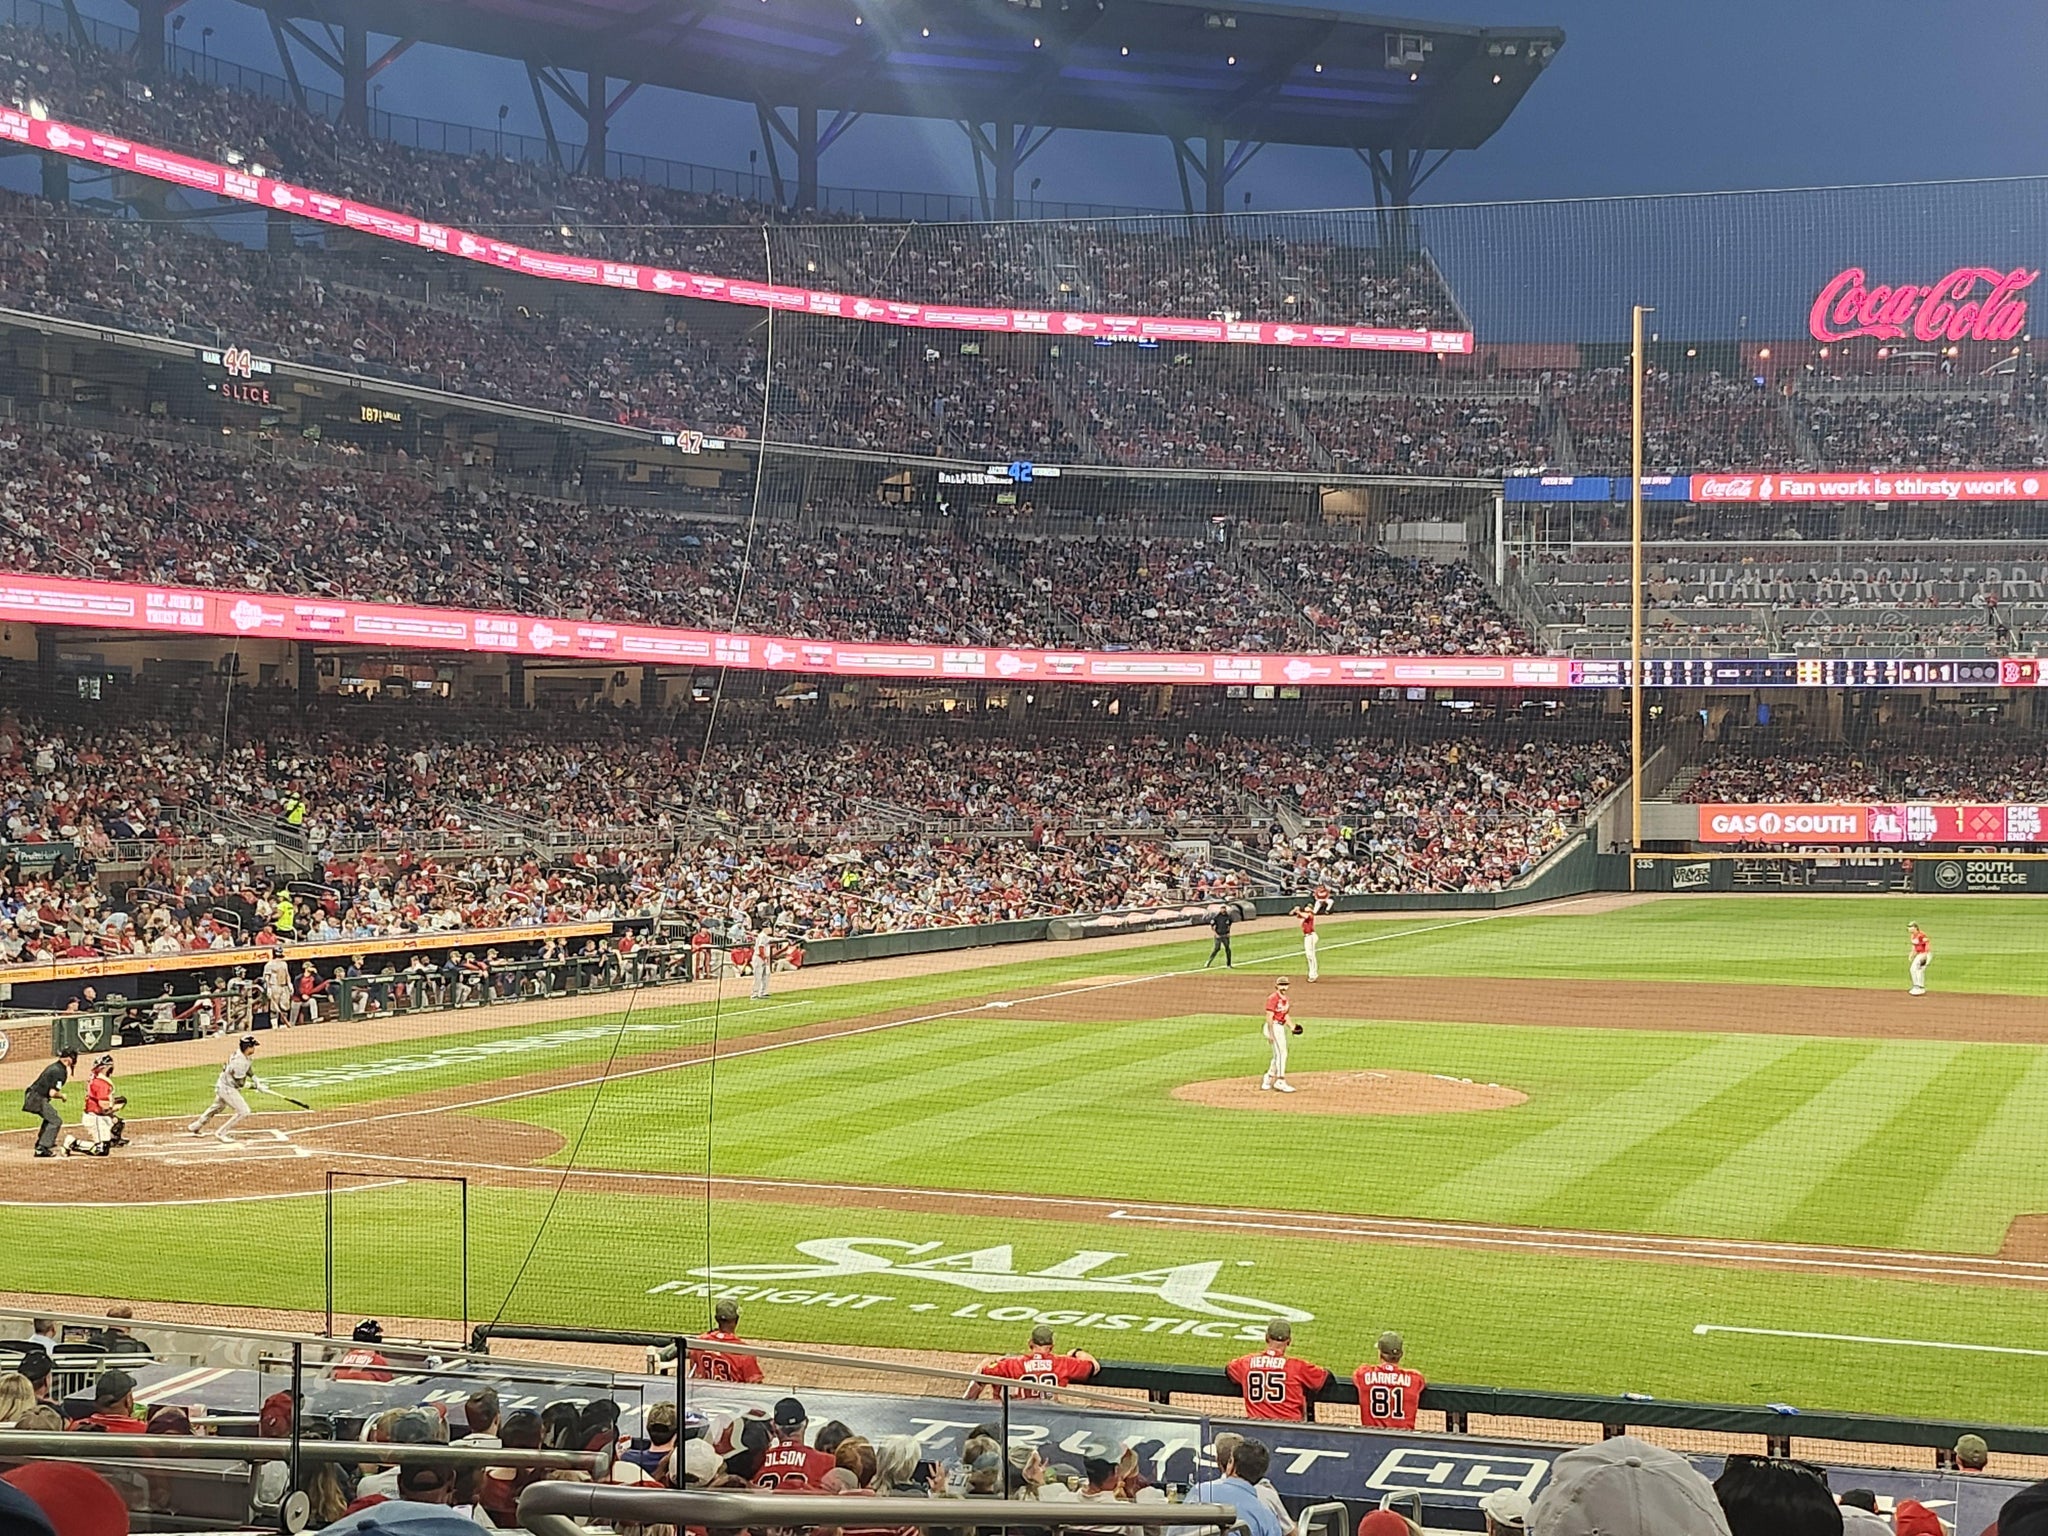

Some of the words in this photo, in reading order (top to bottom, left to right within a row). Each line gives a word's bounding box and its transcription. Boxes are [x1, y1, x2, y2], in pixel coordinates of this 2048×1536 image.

[223, 347, 252, 378] 44
[222, 383, 270, 403] SLICE
[677, 429, 703, 454] 47
[938, 472, 984, 485] BALLPARK
[1008, 461, 1034, 482] 42
[1780, 479, 1815, 496] Fan
[1819, 479, 1870, 495] work
[1874, 478, 1892, 495] is
[1895, 478, 1961, 499] thirsty
[1965, 478, 2016, 494] work
[1699, 568, 1795, 598] HANK
[1808, 568, 1941, 599] AARON
[1913, 664, 1923, 681] 1
[1940, 664, 1950, 682] 1
[1907, 807, 1935, 820] MIL
[1955, 807, 1964, 820] 1
[2007, 807, 2039, 820] CHC
[1712, 815, 1757, 833] GAS
[1784, 815, 1856, 833] SOUTH
[1873, 814, 1901, 833] AL
[1907, 819, 1938, 833] MIN
[1956, 820, 1964, 833] 1
[2007, 819, 2041, 833] CWS
[1908, 833, 1922, 841] TOP
[1637, 860, 1654, 869] 335
[1674, 868, 1710, 877] BRAVES
[1966, 862, 2014, 873] SOUTH
[1966, 873, 2027, 884] COLLEGE
[648, 1281, 896, 1310] FREIGHT
[951, 1303, 1267, 1341] LOGISTICS
[1024, 1359, 1053, 1373] WEISS
[1250, 1355, 1287, 1369] HEFNER
[1247, 1371, 1287, 1404] 85
[1364, 1372, 1411, 1387] GARNEAU
[1370, 1385, 1406, 1419] 81
